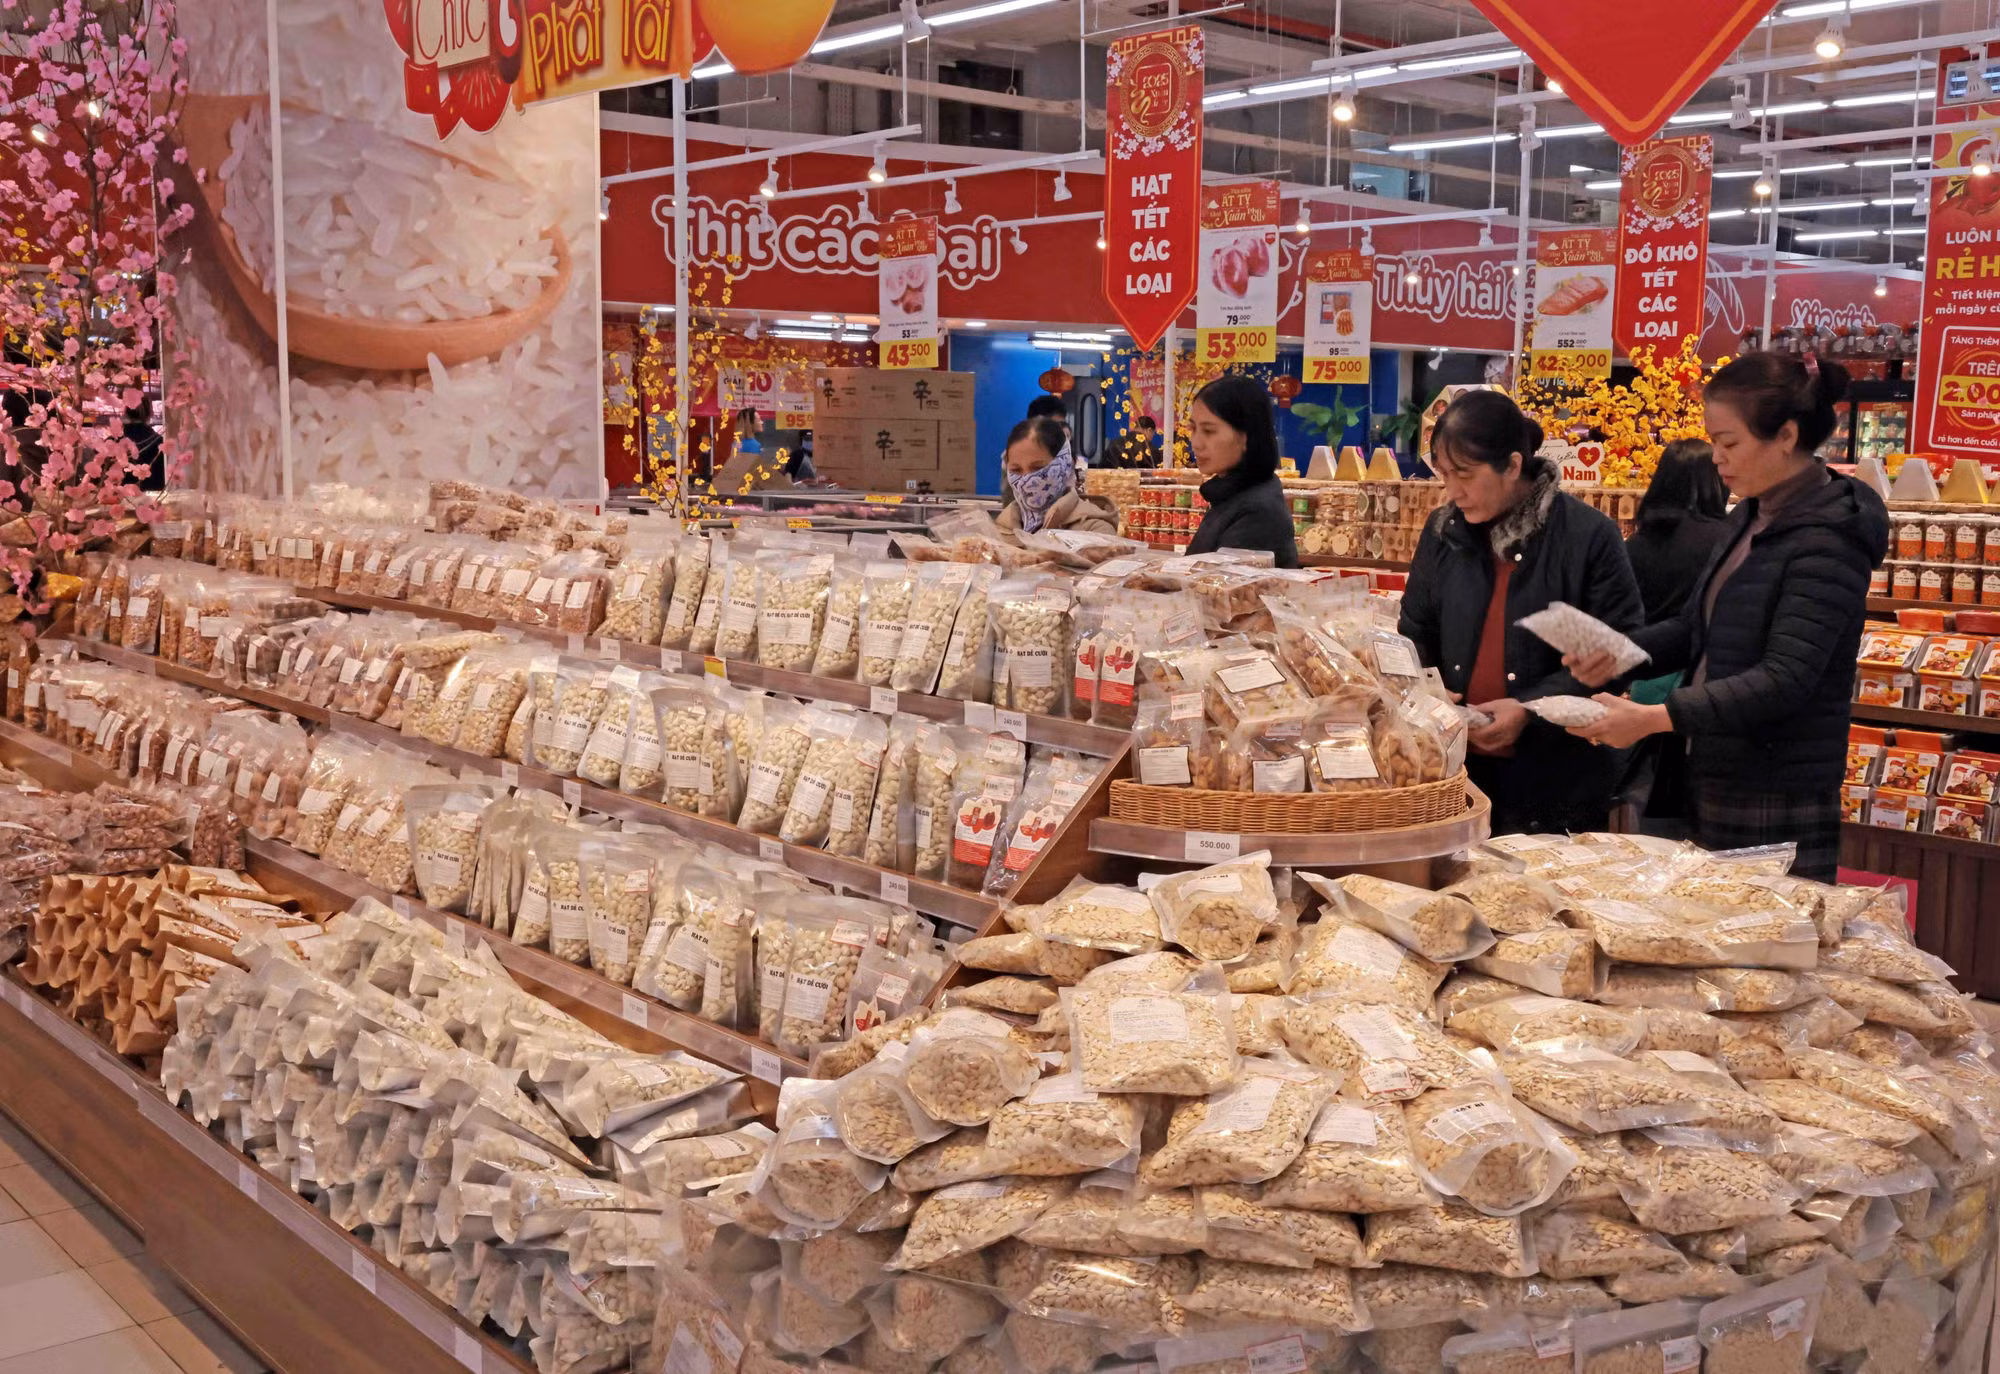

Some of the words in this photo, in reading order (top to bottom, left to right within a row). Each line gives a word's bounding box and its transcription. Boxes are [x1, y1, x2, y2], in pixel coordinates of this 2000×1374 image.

[1131, 173, 1172, 200] HẠT
[1132, 202, 1170, 229] TẾT
[657, 199, 773, 275] Thịt
[1946, 227, 1992, 245] LUÔN
[1129, 236, 1171, 263] CÁC
[1625, 242, 1653, 264] ĐỒ
[1657, 241, 1698, 262] KHÔ
[1936, 247, 1975, 280] RẺ
[1126, 272, 1172, 298] LOẠI
[1642, 267, 1677, 288] TẾT
[1375, 258, 1453, 319] Thủy
[1459, 264, 1503, 317] hải
[1952, 289, 1974, 300] Tiết
[1638, 293, 1678, 313] CÁC
[1935, 303, 1956, 315] mỗi
[1959, 303, 1987, 315] ngày
[1634, 321, 1678, 340] LOẠI
[1976, 335, 2000, 346] THÊM
[1207, 332, 1267, 359] 53.000
[1312, 360, 1362, 380] 75.000
[1563, 466, 1597, 481] Nam
[1200, 841, 1230, 850] 550.000
